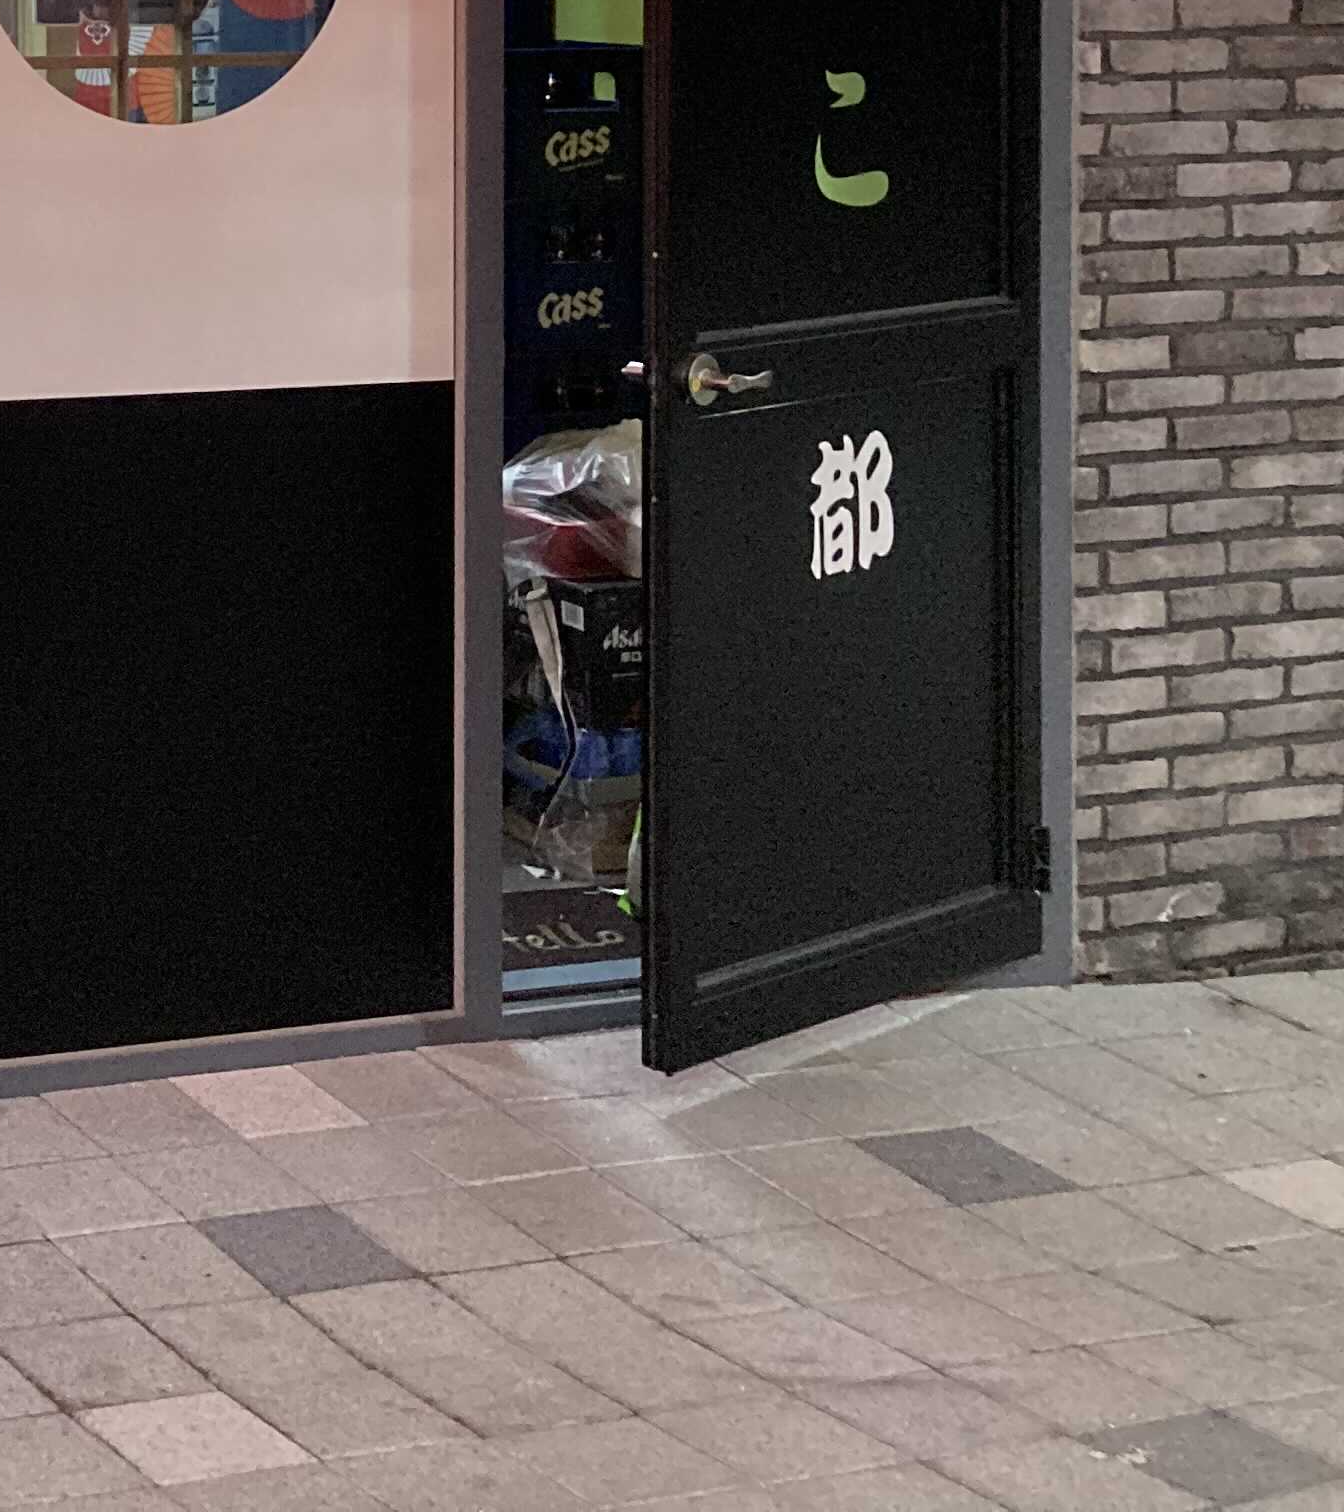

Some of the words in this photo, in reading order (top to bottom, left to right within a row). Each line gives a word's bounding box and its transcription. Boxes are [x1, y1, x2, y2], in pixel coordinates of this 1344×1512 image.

[544, 125, 611, 168] Cass
[536, 286, 605, 330] Cass
[811, 430, 895, 580] 都
